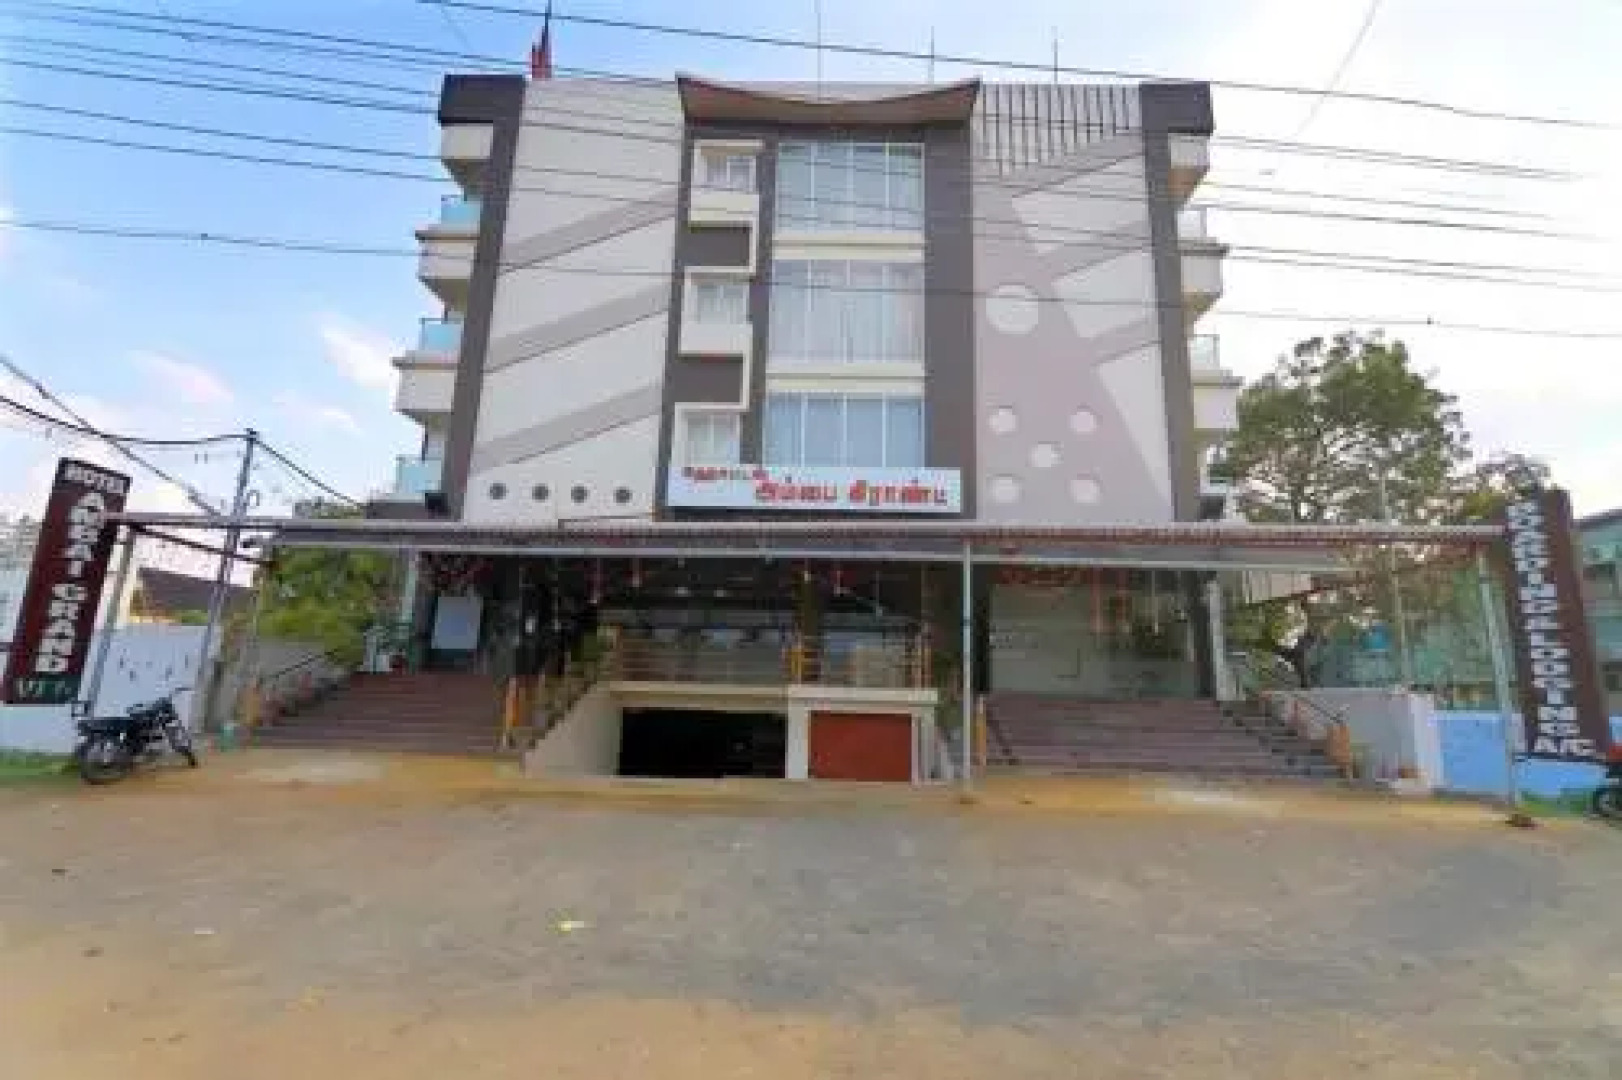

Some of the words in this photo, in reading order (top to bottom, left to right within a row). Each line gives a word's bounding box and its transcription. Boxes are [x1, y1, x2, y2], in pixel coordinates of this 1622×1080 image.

[35, 583, 88, 673] GRAND
[1530, 633, 1579, 735] LODGING
[1534, 738, 1597, 756] A/C
